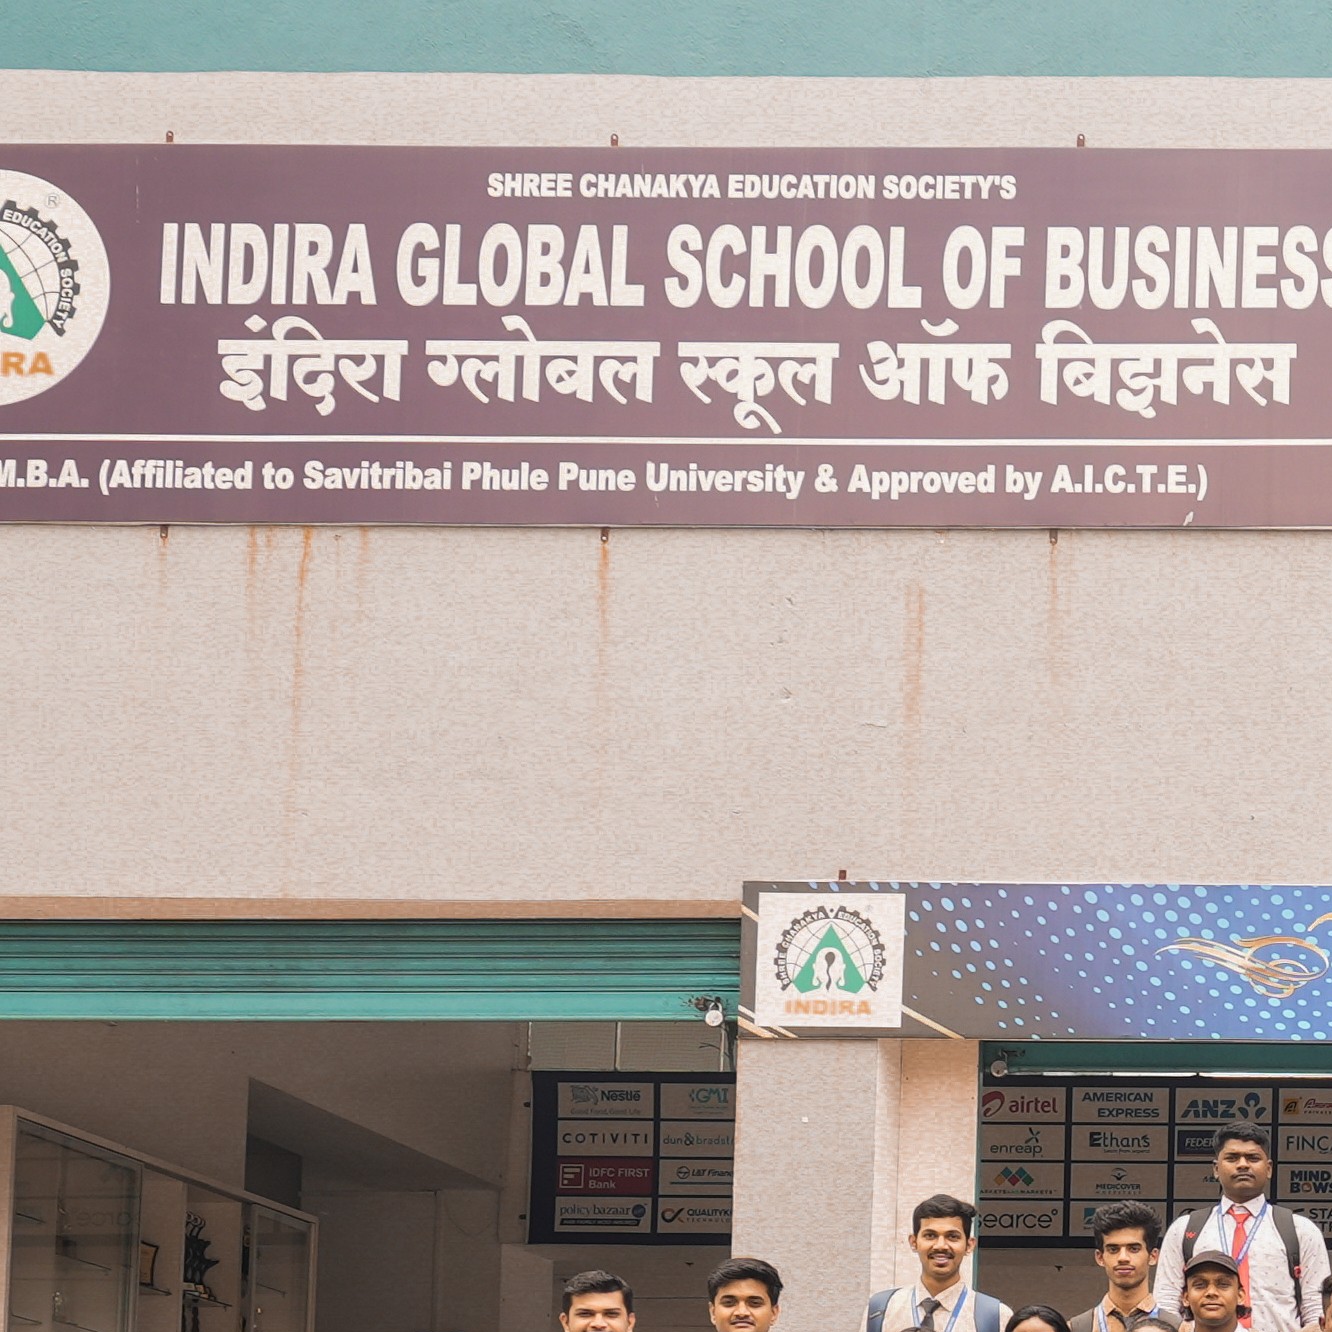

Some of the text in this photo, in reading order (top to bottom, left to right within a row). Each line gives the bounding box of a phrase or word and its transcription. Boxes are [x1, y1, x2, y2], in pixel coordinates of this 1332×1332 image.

[488, 173, 1016, 199] SHREE CHANAKYA EDUCATION SOCIETY'S
[161, 223, 376, 304] INDIRA
[397, 223, 644, 306] GLOBAL
[665, 224, 921, 309] SCHOOL
[943, 226, 1024, 309] OF
[218, 315, 1297, 434] इंदिरा ग्लोबल स्कूल ऑफ बिझनेस
[100, 459, 253, 495] (Affiliated
[262, 462, 294, 489] to
[303, 461, 452, 490] Savitribai
[462, 462, 549, 490] Phule
[559, 462, 636, 491] Pune
[646, 461, 805, 499] University
[815, 464, 838, 492] &
[848, 465, 995, 500] Approved
[1006, 465, 1042, 500] by
[1051, 465, 1207, 500] A.I.C.T.E.)
[785, 999, 872, 1015] INDIRA
[1082, 1092, 1154, 1102] AMERICAN
[1009, 1096, 1058, 1114] airtel
[1181, 1100, 1237, 1118] ANZ
[1097, 1108, 1160, 1118] EXPRESS
[562, 1132, 649, 1145] COTIVITI
[1185, 1138, 1214, 1148] FEDER
[990, 1144, 1043, 1158] enreap
[589, 1169, 649, 1178] IDFC FIRST
[1290, 1170, 1331, 1182] MIND
[588, 1180, 616, 1189] Bank
[1096, 1183, 1141, 1191] MEDICOVER
